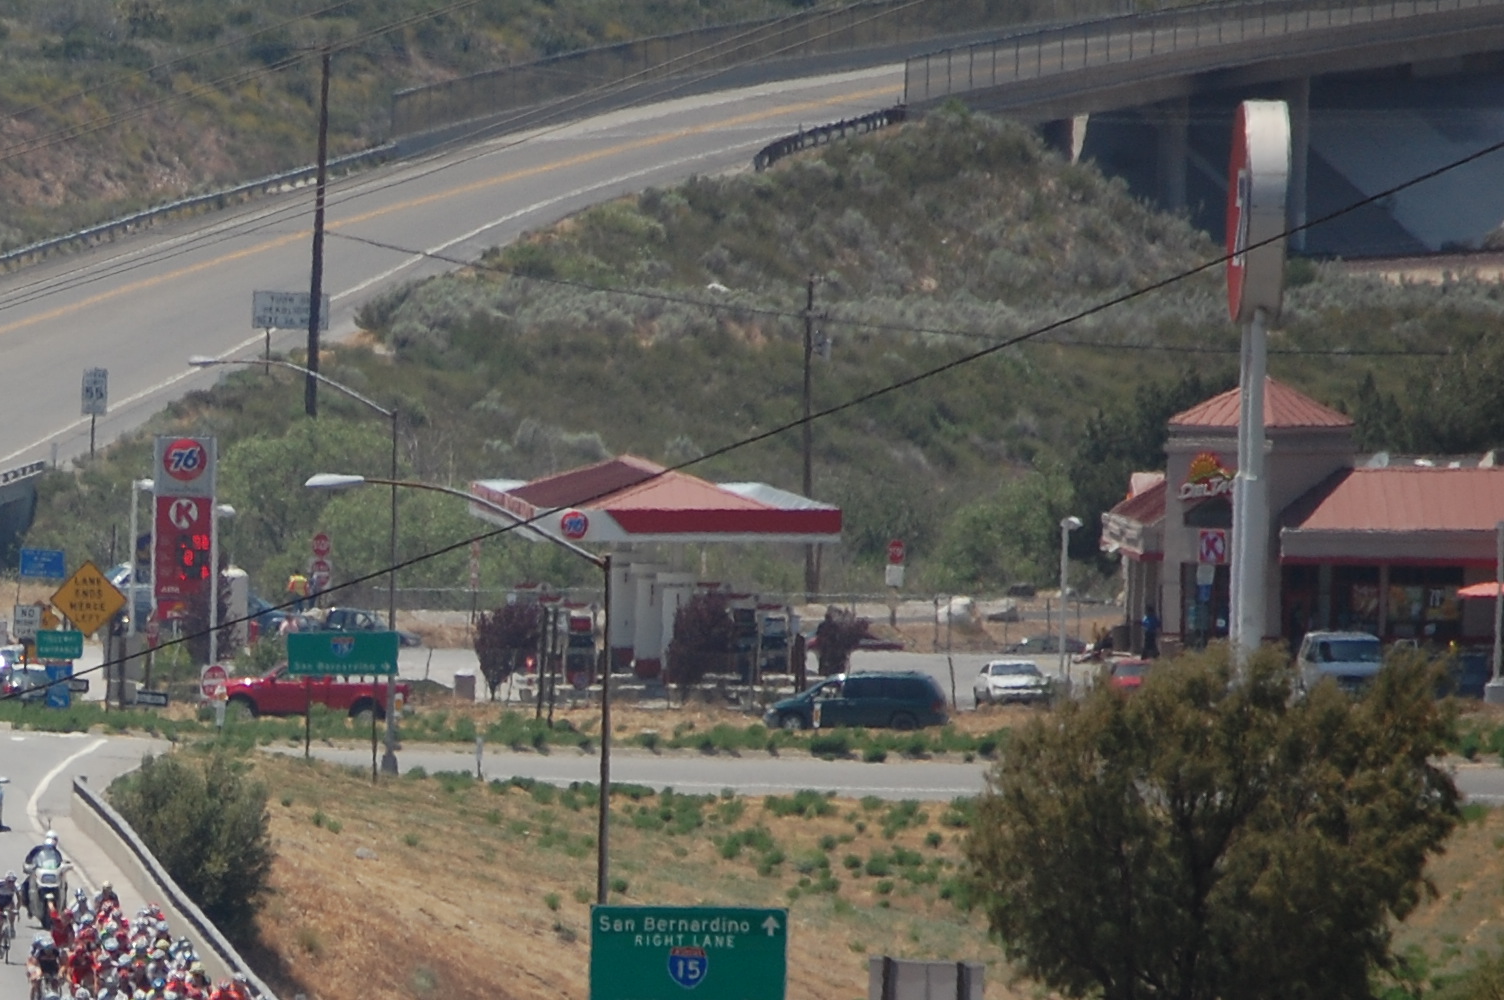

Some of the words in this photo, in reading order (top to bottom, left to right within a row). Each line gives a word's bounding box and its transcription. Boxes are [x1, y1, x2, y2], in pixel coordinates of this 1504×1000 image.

[171, 447, 199, 470] 76
[74, 576, 101, 586] LANE
[75, 588, 103, 598] ENDS
[21, 608, 35, 618] NO
[599, 916, 635, 932] San
[643, 917, 751, 933] Bernardino
[634, 935, 684, 947] RIGHT
[693, 935, 735, 948] LANE
[676, 959, 701, 980] 15
